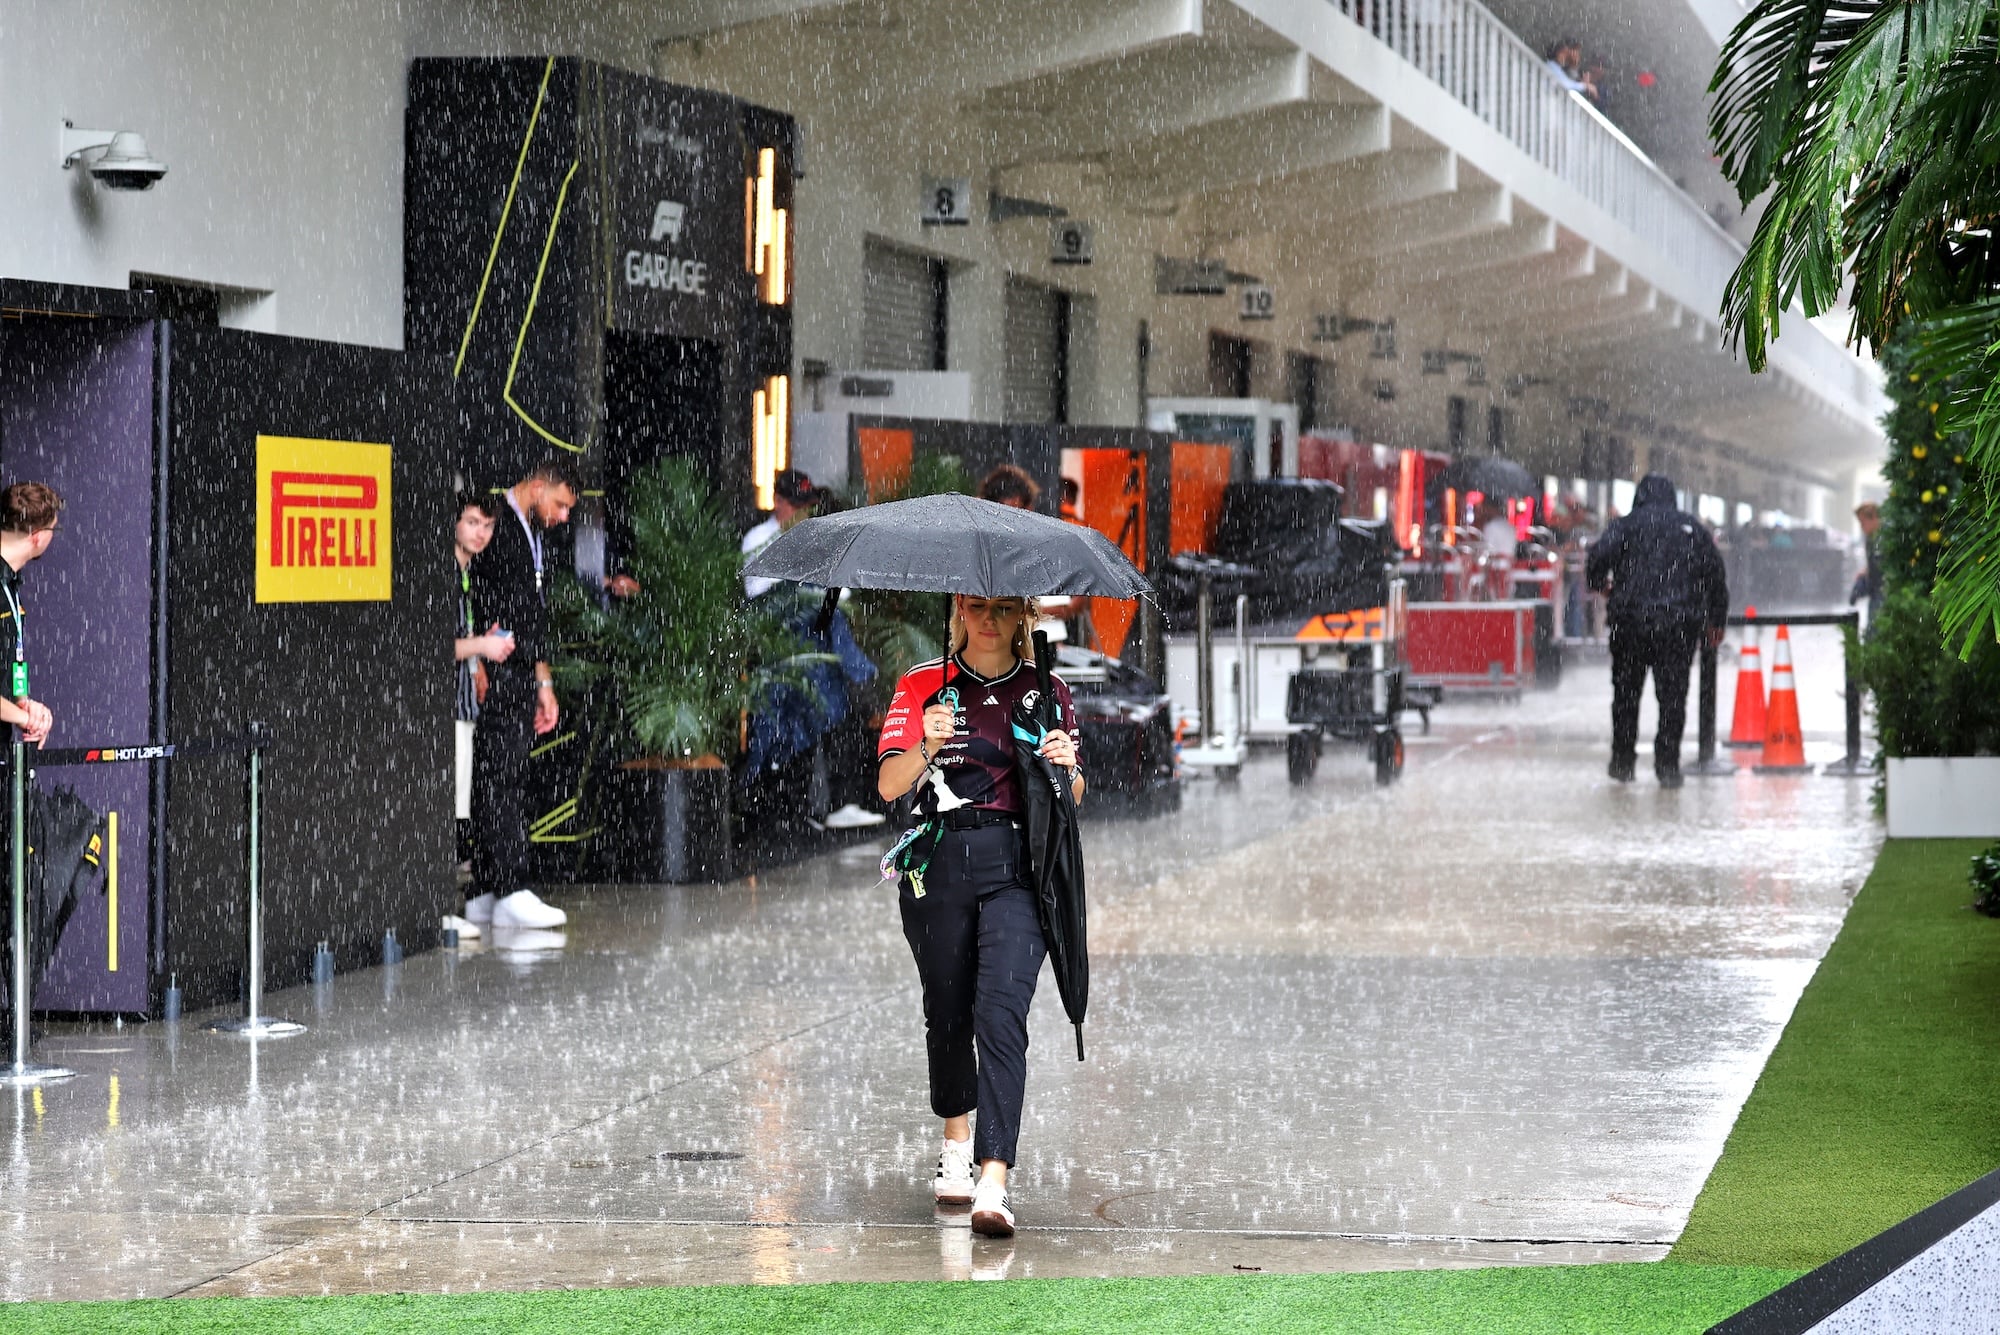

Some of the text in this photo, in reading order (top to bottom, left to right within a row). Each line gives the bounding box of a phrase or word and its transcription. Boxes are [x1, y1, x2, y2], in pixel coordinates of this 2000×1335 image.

[936, 187, 954, 215] 8
[1064, 230, 1081, 254] 9
[624, 250, 707, 296] GARAGE
[1244, 290, 1273, 313] 10
[270, 471, 378, 567] PIRELLI
[952, 716, 967, 726] BS
[115, 748, 136, 761] HOT
